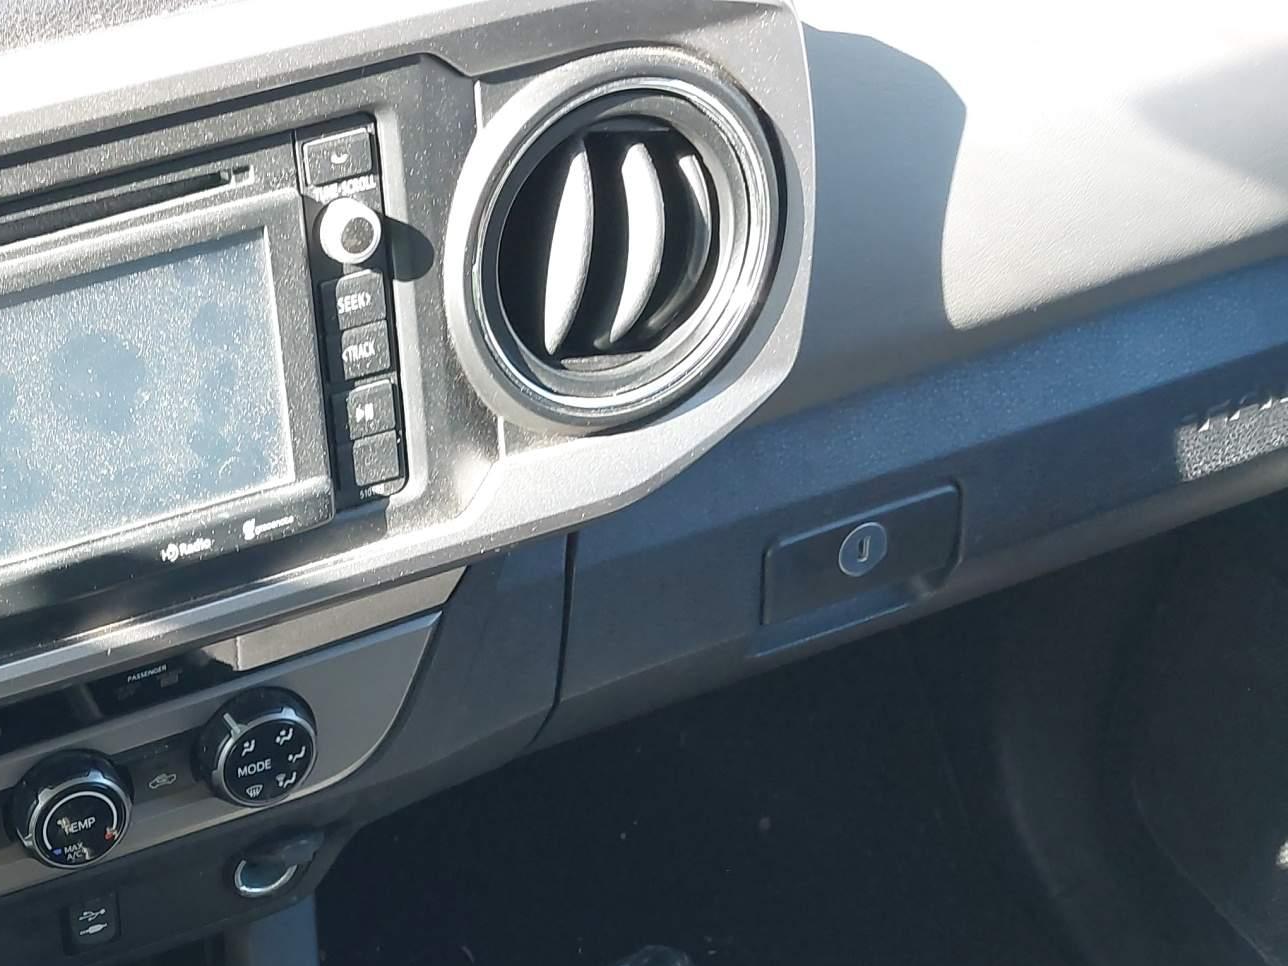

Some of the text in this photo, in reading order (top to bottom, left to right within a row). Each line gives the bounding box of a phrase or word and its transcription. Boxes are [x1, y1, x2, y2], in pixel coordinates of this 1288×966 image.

[127, 663, 167, 683] PASSENGER
[237, 758, 272, 778] MODE
[64, 841, 84, 854] MAX
